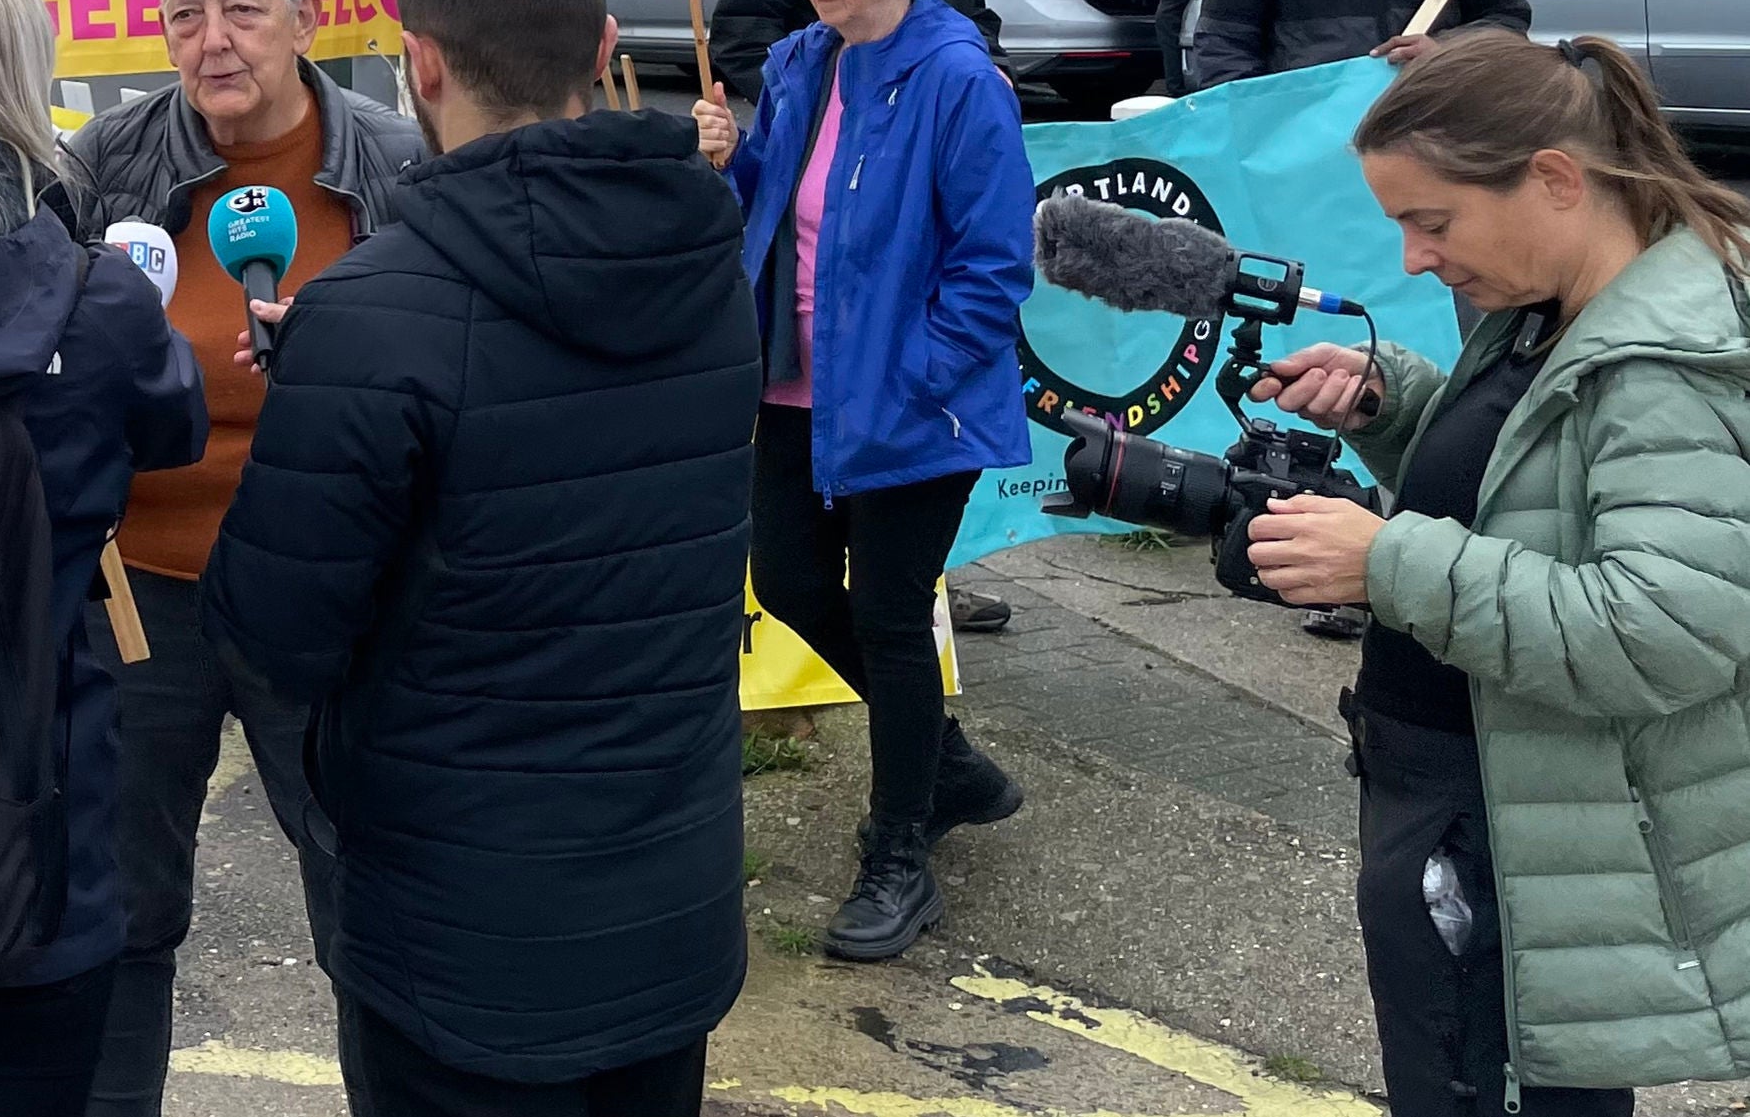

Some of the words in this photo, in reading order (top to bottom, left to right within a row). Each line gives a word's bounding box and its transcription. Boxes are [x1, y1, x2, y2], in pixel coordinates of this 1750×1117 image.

[227, 215, 270, 228] GREATEST
[228, 225, 248, 235] HITS
[229, 230, 257, 243] RADIO
[997, 471, 1067, 501] Keepin
